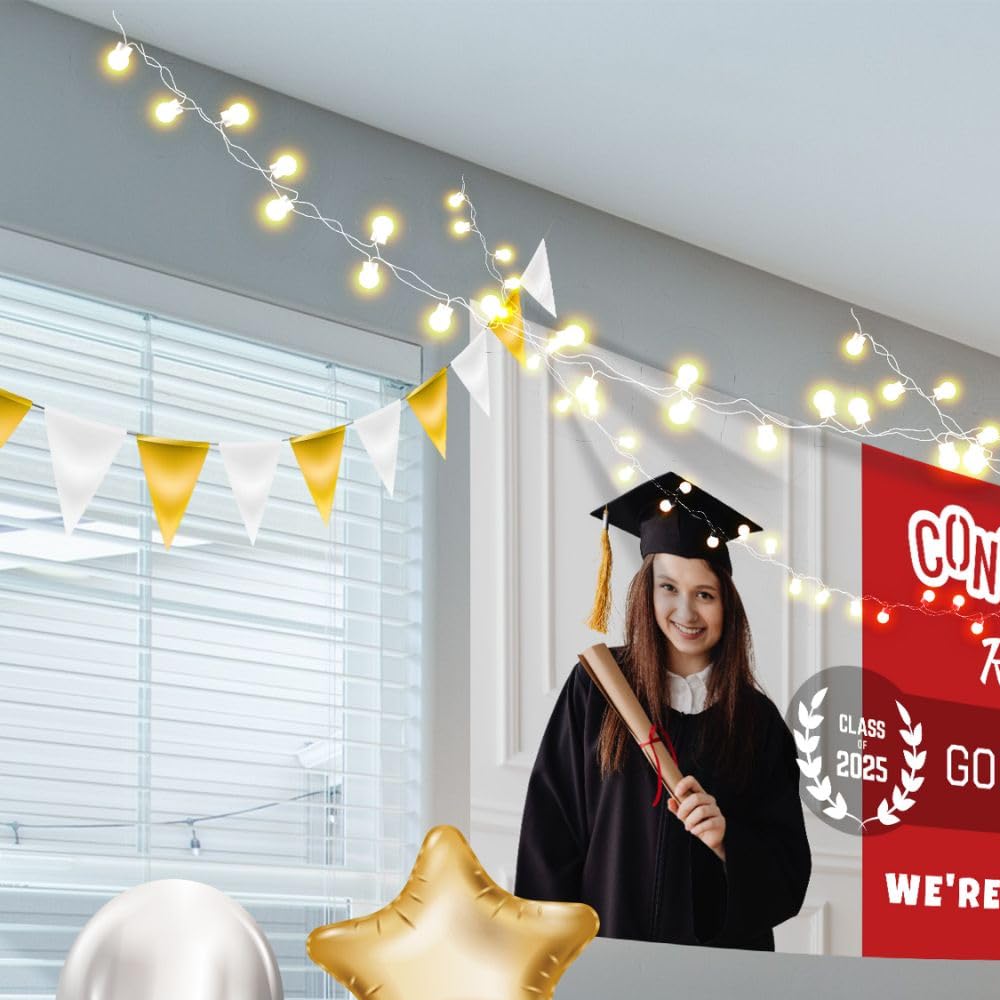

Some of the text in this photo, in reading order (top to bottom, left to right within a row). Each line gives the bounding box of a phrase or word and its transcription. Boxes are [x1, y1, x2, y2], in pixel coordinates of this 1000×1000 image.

[839, 713, 886, 739] CLASS
[857, 739, 868, 750] OF
[836, 750, 888, 783] 2025
[885, 872, 1000, 910] WE'RE
